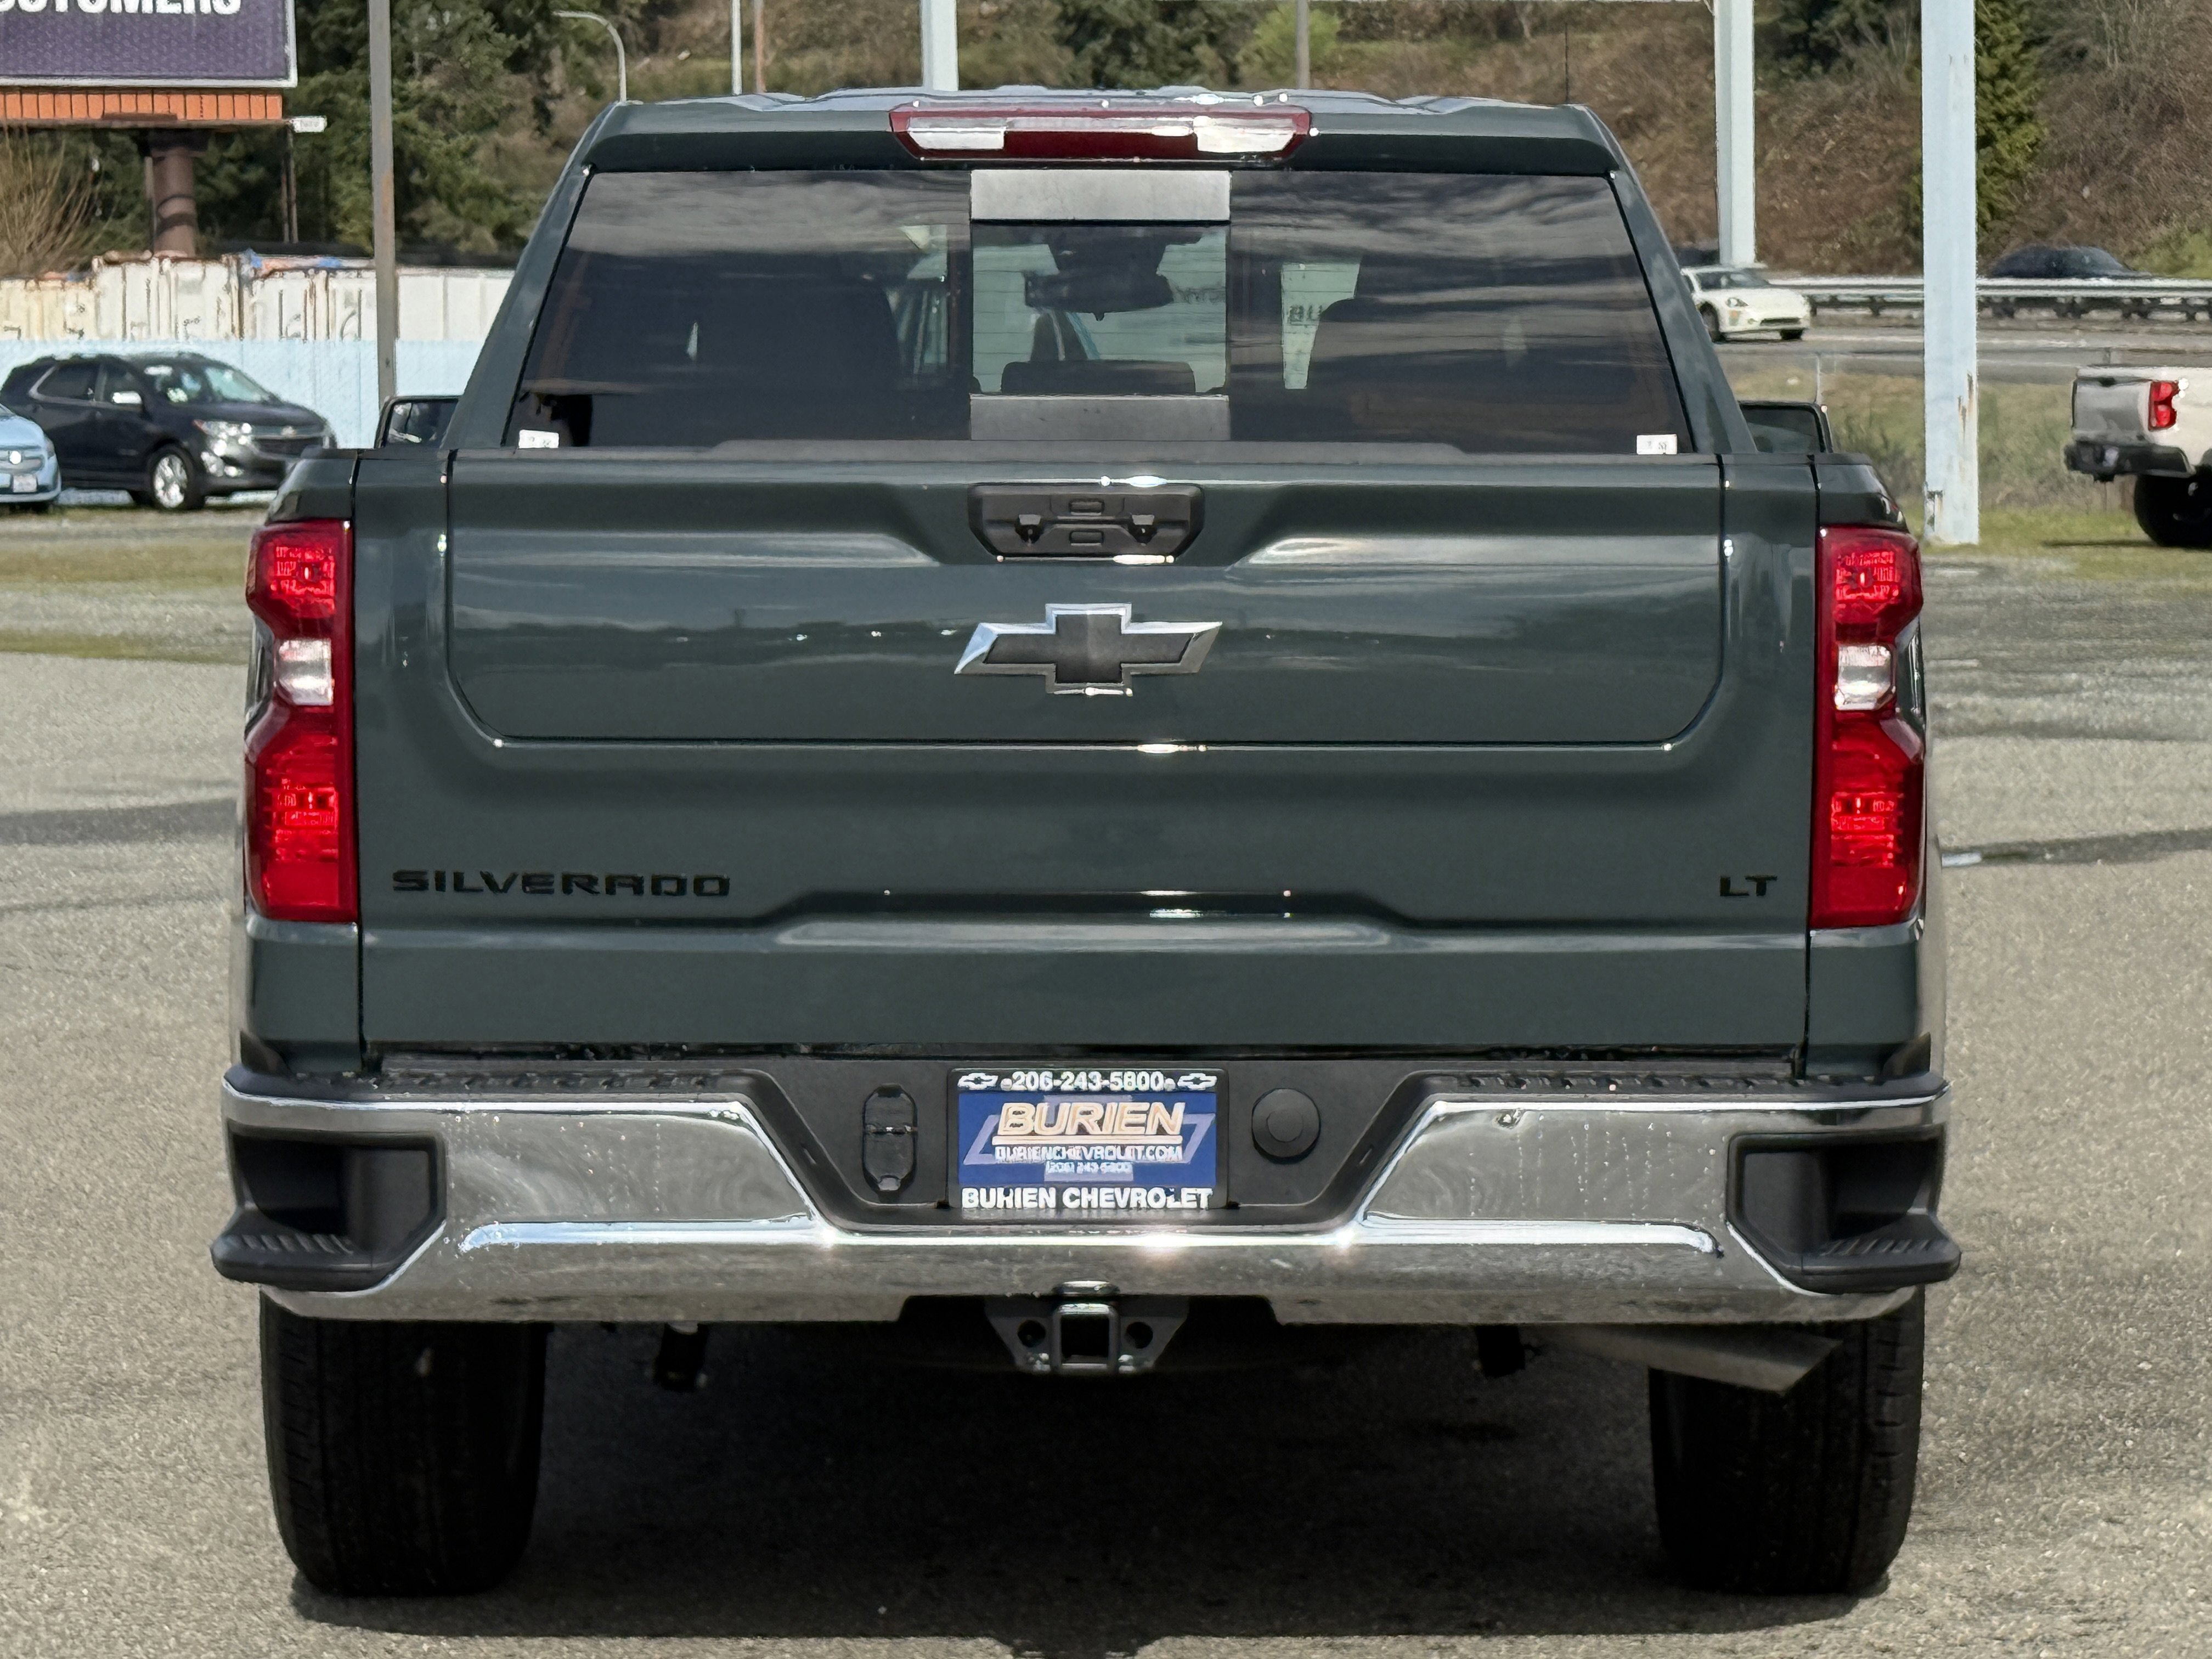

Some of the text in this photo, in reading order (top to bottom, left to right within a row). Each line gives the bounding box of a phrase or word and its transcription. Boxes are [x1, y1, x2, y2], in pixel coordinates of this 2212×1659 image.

[392, 870, 730, 896] SILVERADO
[1720, 874, 1778, 896] LT
[997, 1102, 1186, 1135] BURIEN
[962, 1187, 1214, 1209] BURIEN CHEVROLET
